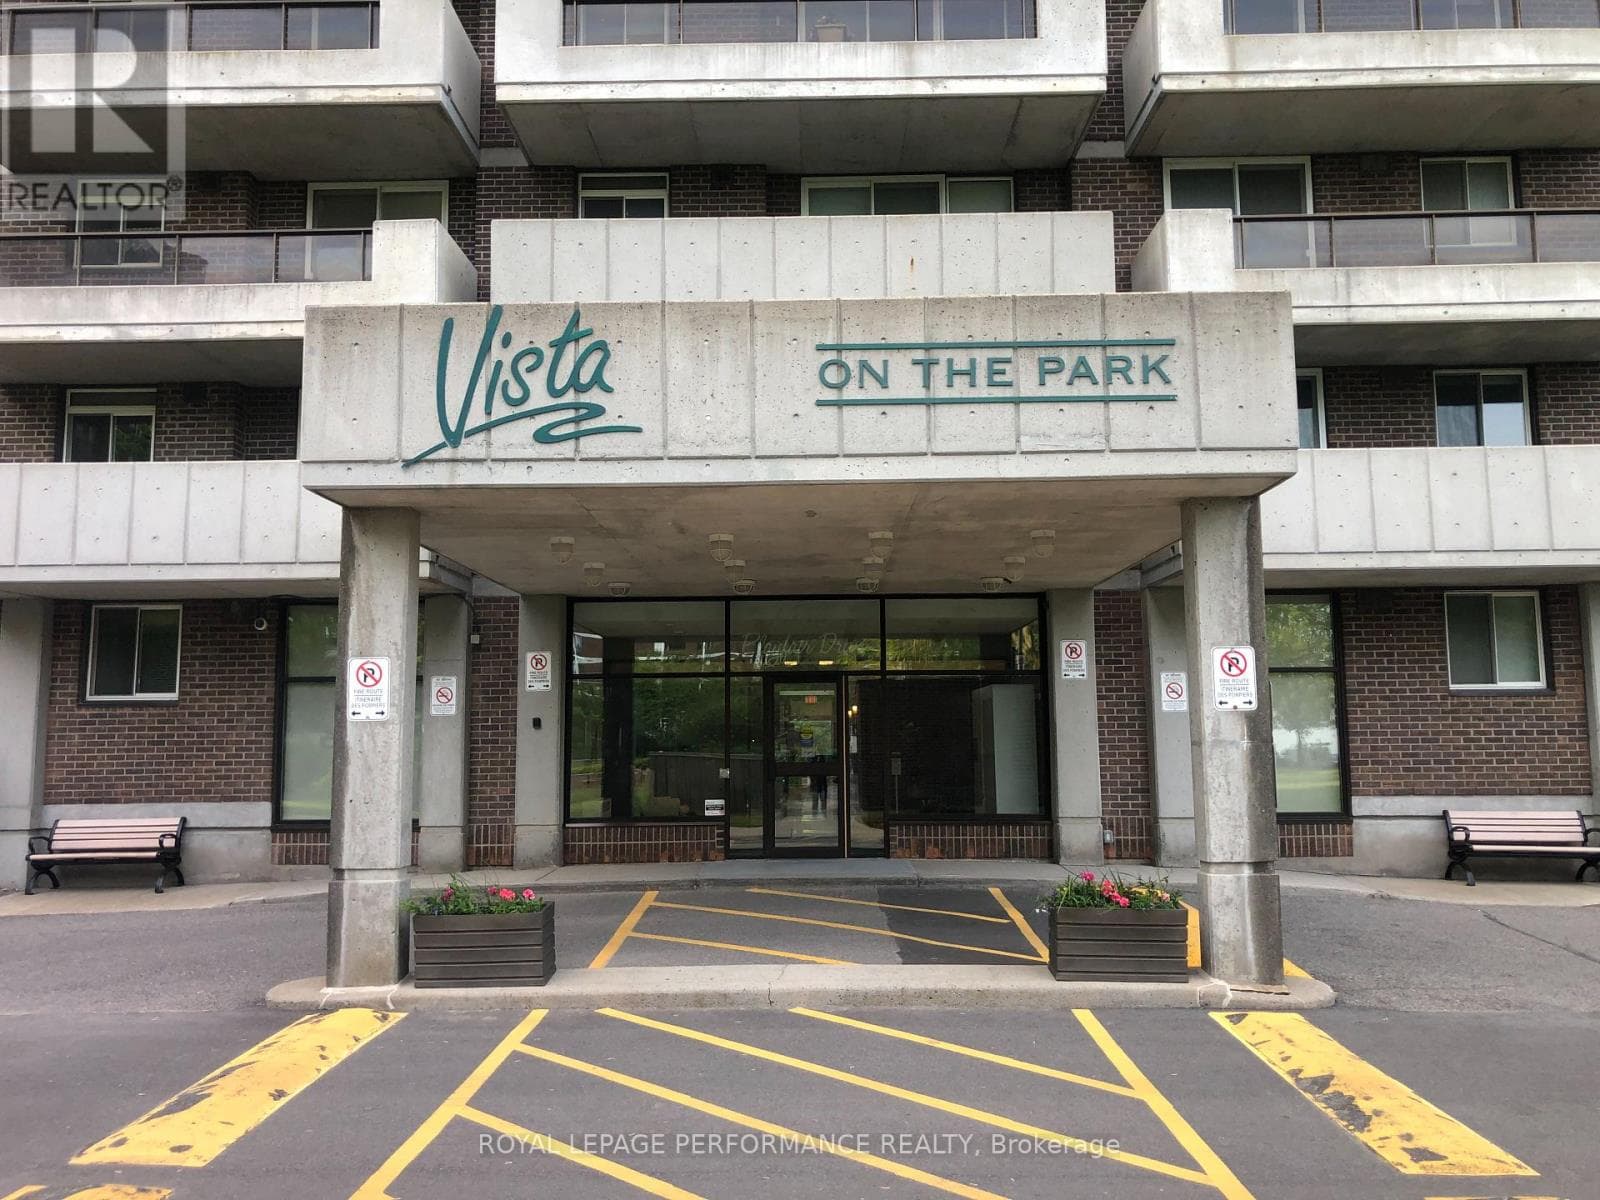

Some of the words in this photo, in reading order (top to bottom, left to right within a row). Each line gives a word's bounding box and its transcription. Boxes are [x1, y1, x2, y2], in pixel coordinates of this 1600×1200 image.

[436, 304, 614, 448] Vista
[818, 358, 889, 389] ON
[911, 357, 1014, 389] THE
[1038, 354, 1172, 386] PARK
